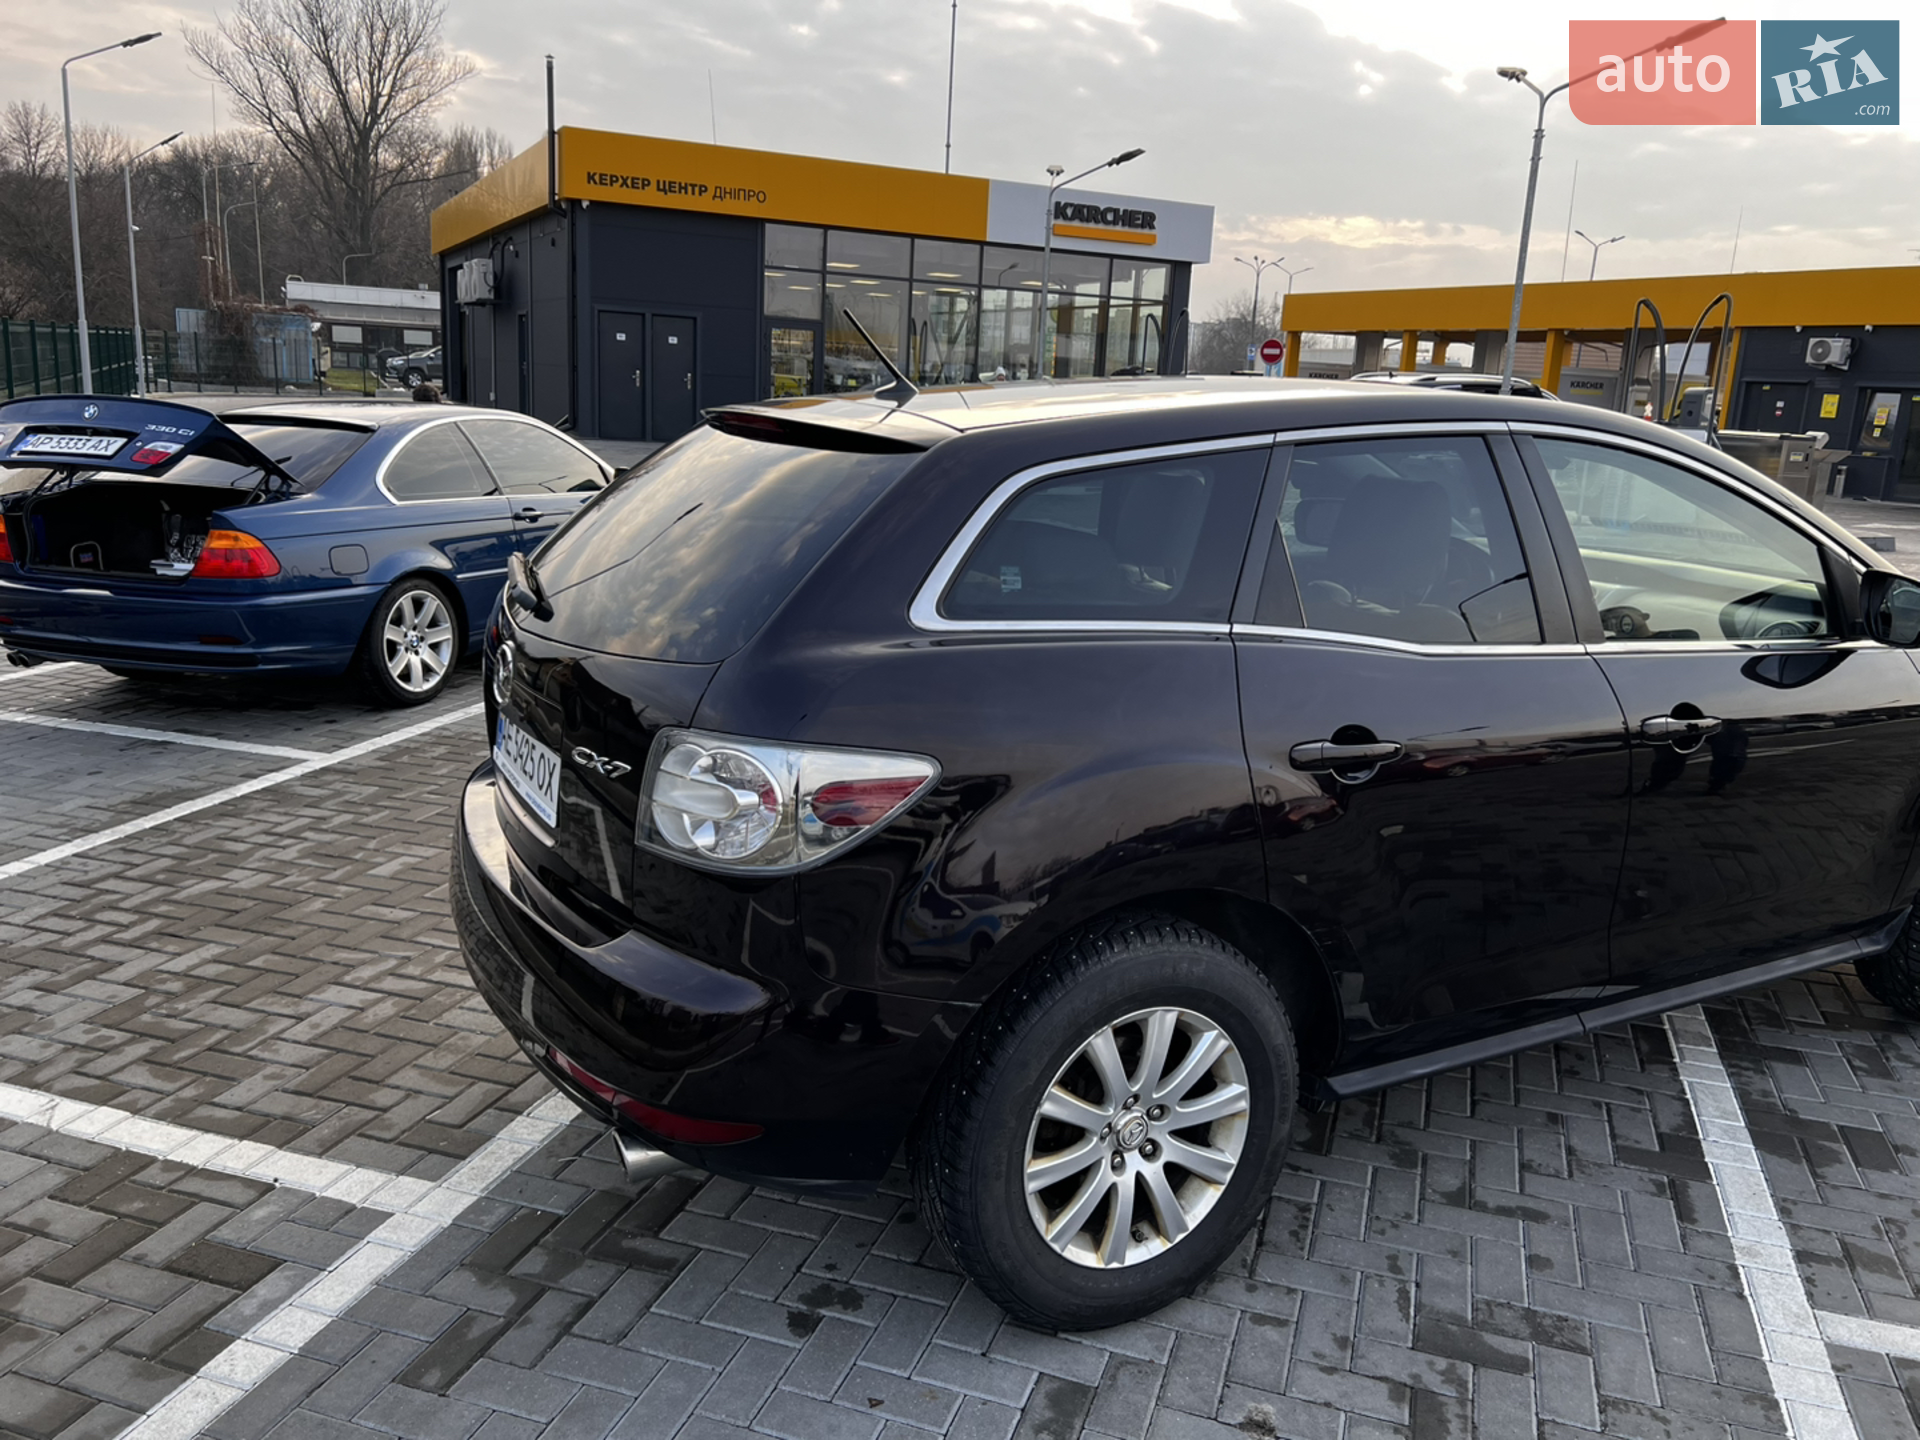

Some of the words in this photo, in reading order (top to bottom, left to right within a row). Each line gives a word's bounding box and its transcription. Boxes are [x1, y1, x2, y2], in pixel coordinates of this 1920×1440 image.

[586, 171, 651, 190] КЕРХЕР
[656, 179, 708, 197] ЦЕНТР
[712, 186, 767, 204] ДНІПРО
[28, 436, 54, 449] AP
[50, 437, 92, 450] 5333
[86, 439, 118, 452] AX
[145, 424, 177, 433] 330
[536, 752, 557, 802] OX
[571, 746, 632, 778] CX-7
